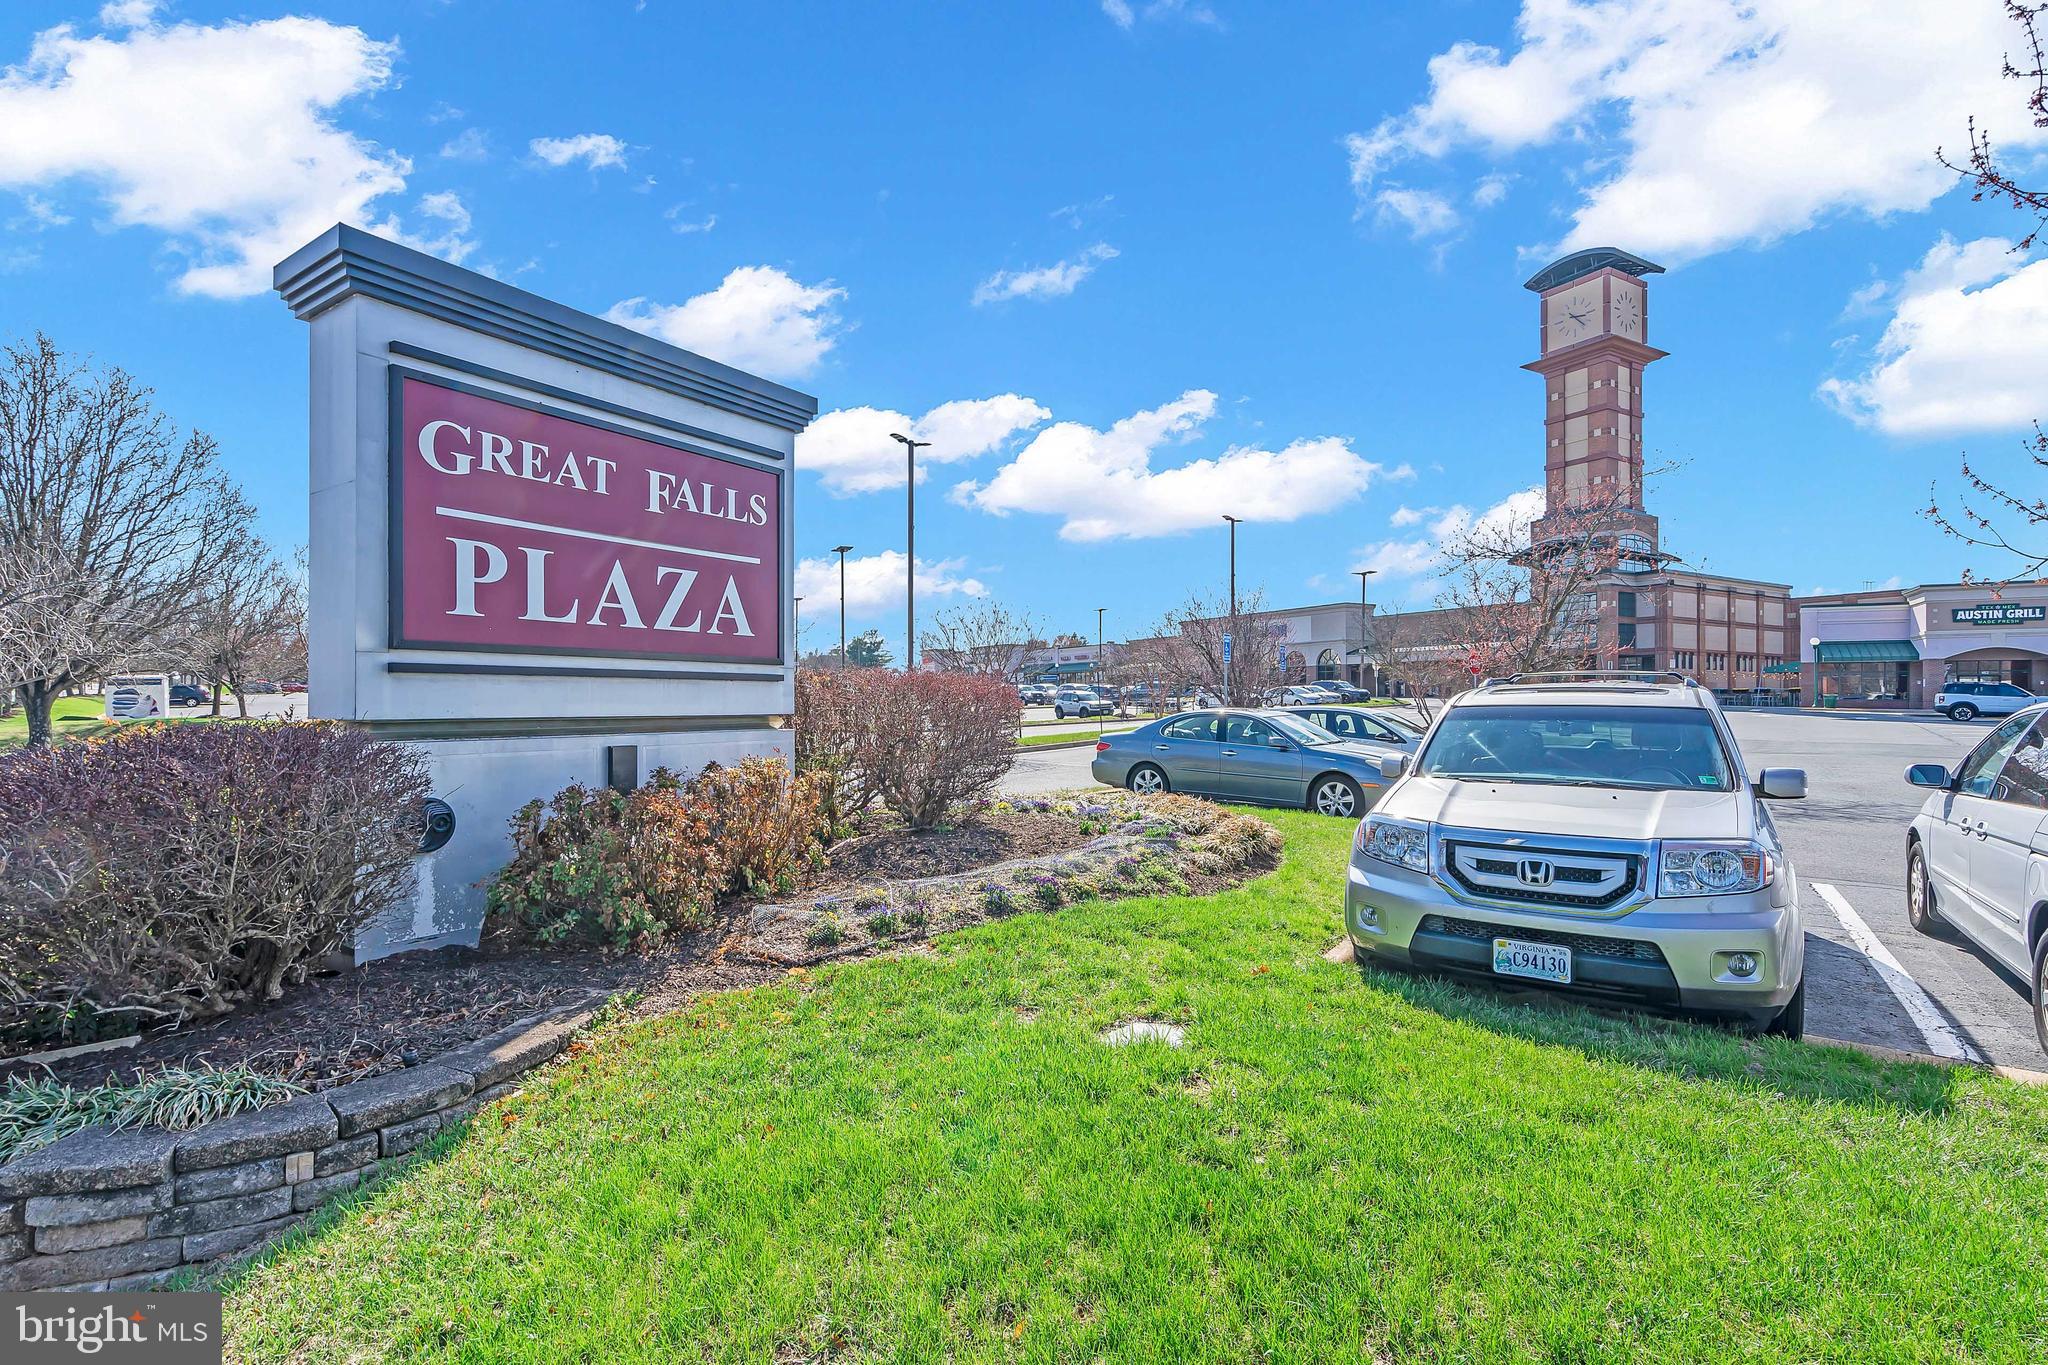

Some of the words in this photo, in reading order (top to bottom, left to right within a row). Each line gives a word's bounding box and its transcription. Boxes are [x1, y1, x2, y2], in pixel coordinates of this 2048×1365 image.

[418, 420, 616, 495] GREAT
[645, 469, 768, 526] FALLS
[446, 537, 755, 637] PLAZA
[1956, 610, 2003, 620] AUSTIN
[2006, 608, 2044, 618] GRILL
[1513, 943, 1550, 955] VIRGINIA
[1512, 951, 1567, 974] C94130
